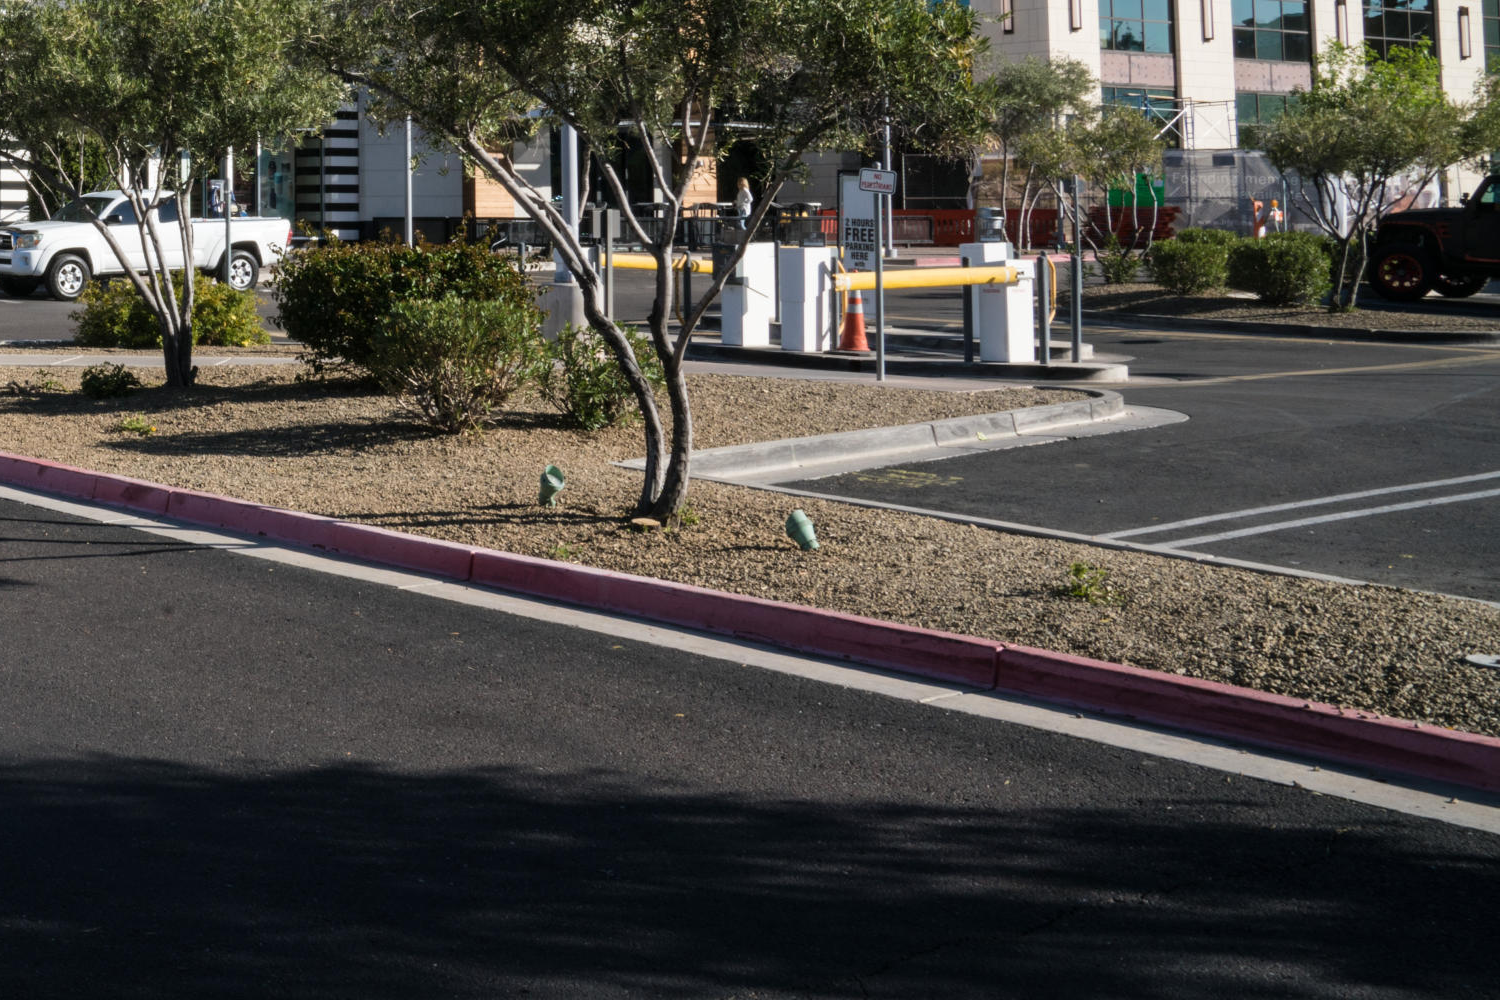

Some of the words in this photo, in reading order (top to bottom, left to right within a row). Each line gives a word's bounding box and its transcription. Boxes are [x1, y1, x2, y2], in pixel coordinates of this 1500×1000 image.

[845, 218, 851, 227] 2
[852, 218, 875, 228] HOURS
[845, 227, 875, 243] FREE
[845, 242, 875, 252] PARKING
[850, 251, 869, 261] HERE
